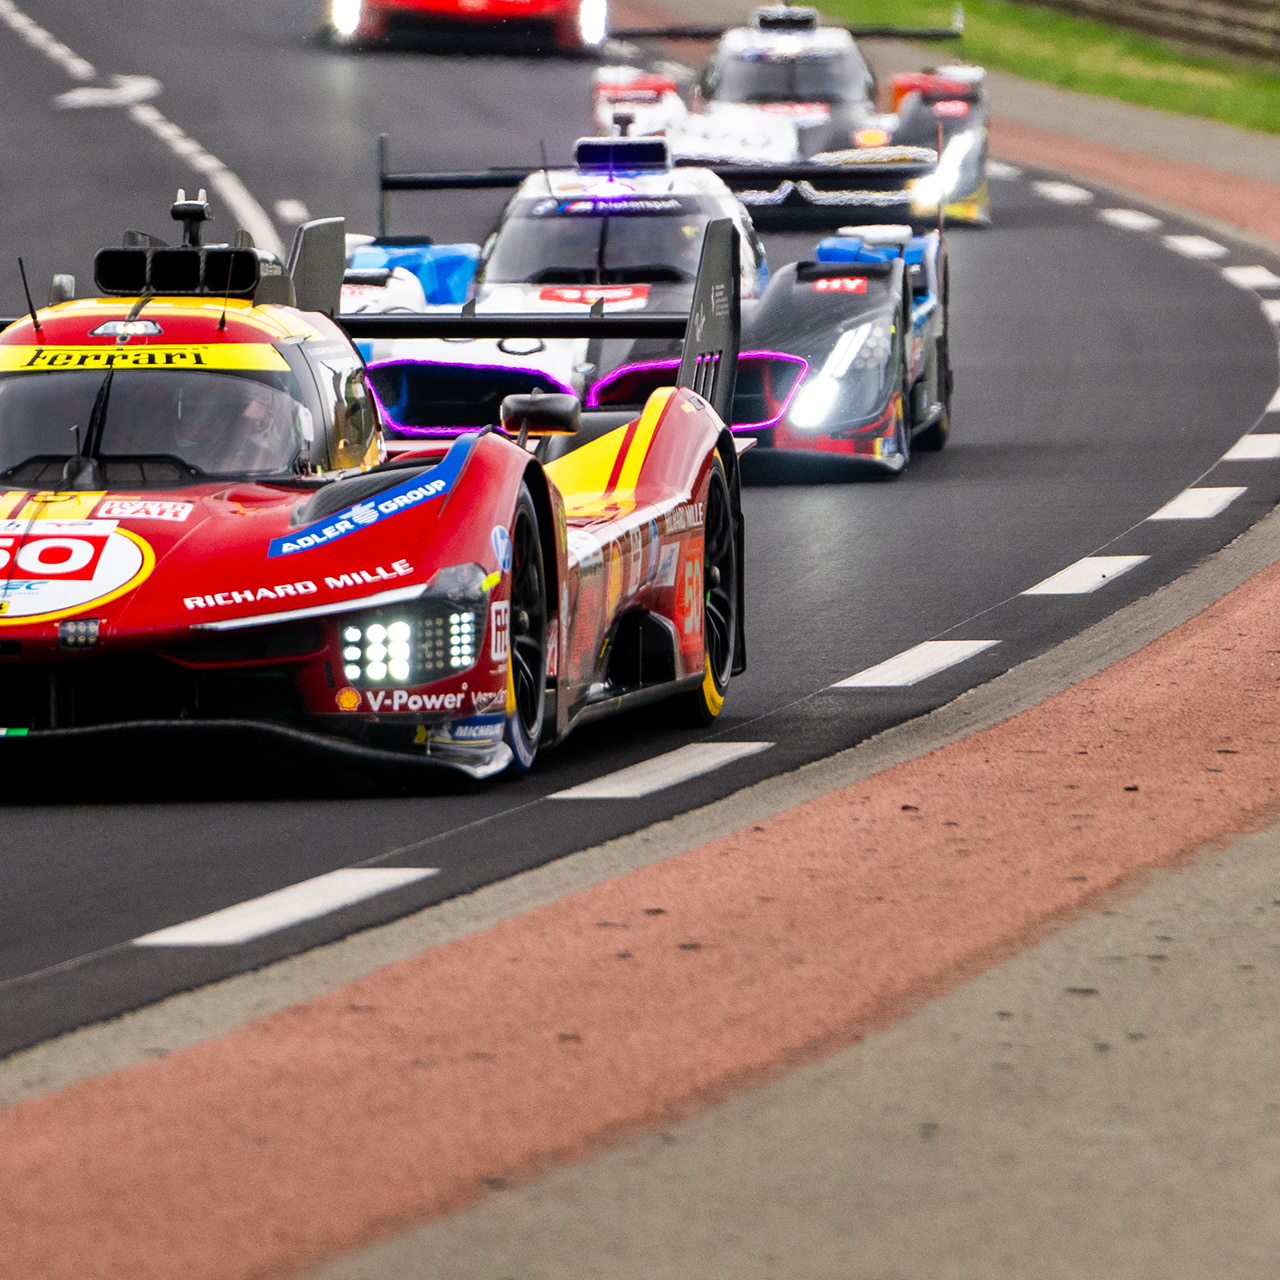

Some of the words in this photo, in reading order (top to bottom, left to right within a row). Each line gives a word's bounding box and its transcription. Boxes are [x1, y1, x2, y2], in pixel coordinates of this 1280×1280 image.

[20, 346, 207, 367] Ferrari
[281, 520, 355, 553] ADLER
[377, 479, 447, 514] GROUP
[183, 580, 318, 610] RICHARD
[324, 558, 415, 590] MILLE
[365, 690, 466, 711] V-Power
